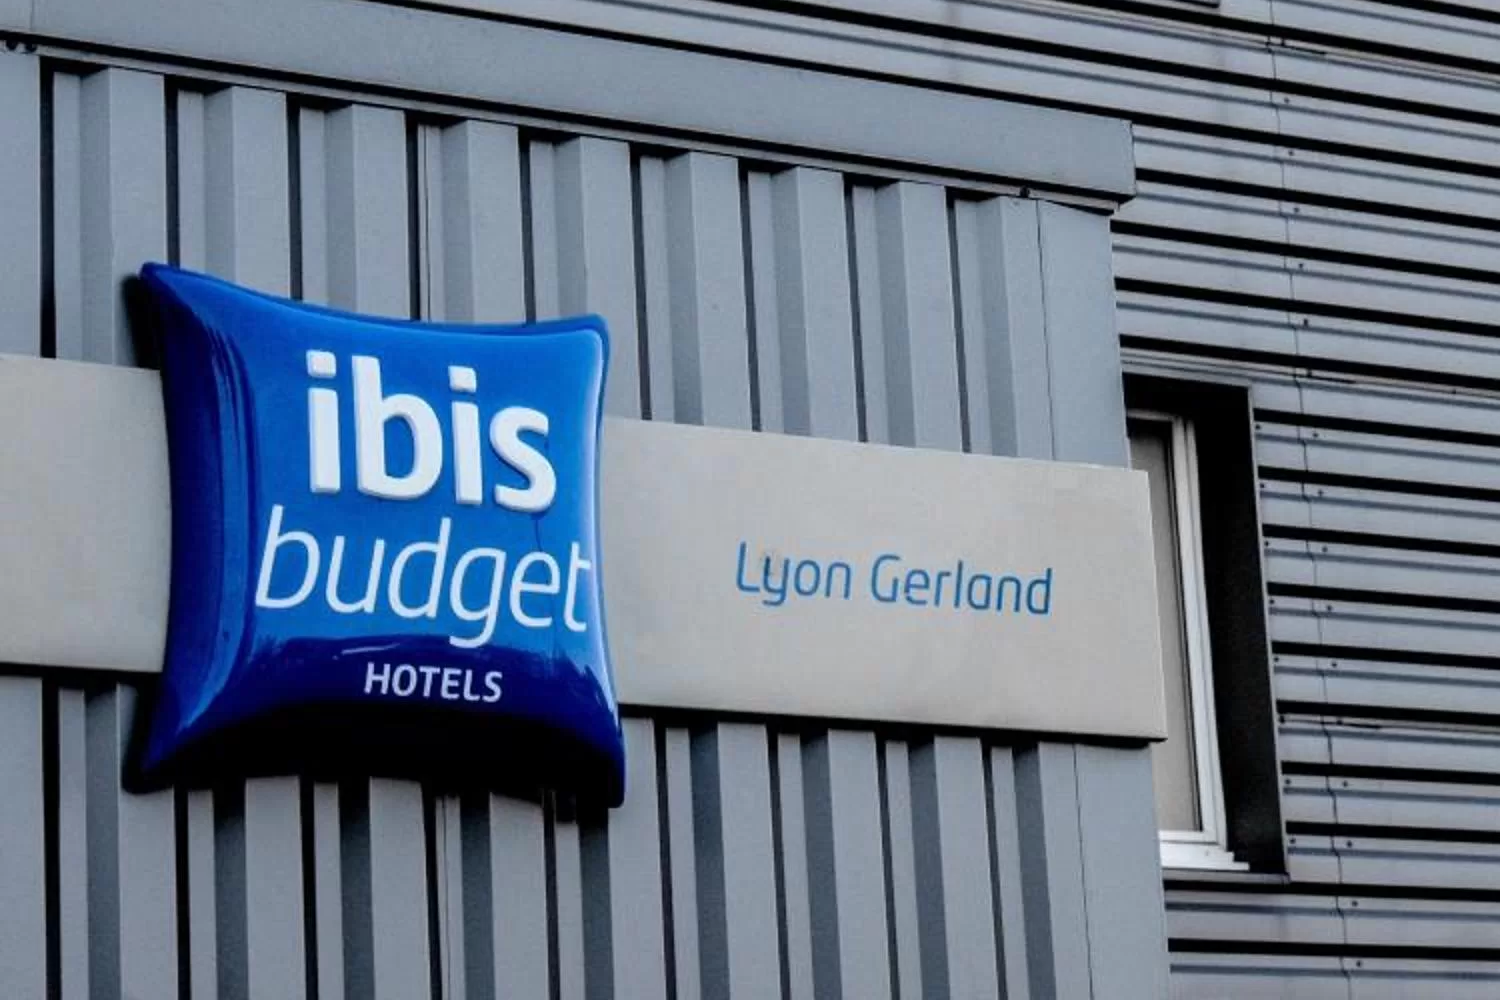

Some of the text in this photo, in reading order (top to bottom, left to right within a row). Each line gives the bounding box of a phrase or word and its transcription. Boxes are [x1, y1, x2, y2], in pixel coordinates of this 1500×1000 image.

[306, 349, 557, 513] ibis
[255, 505, 592, 648] budget
[736, 540, 1053, 615] Lyon Gerland
[363, 661, 503, 703] HOTELS
